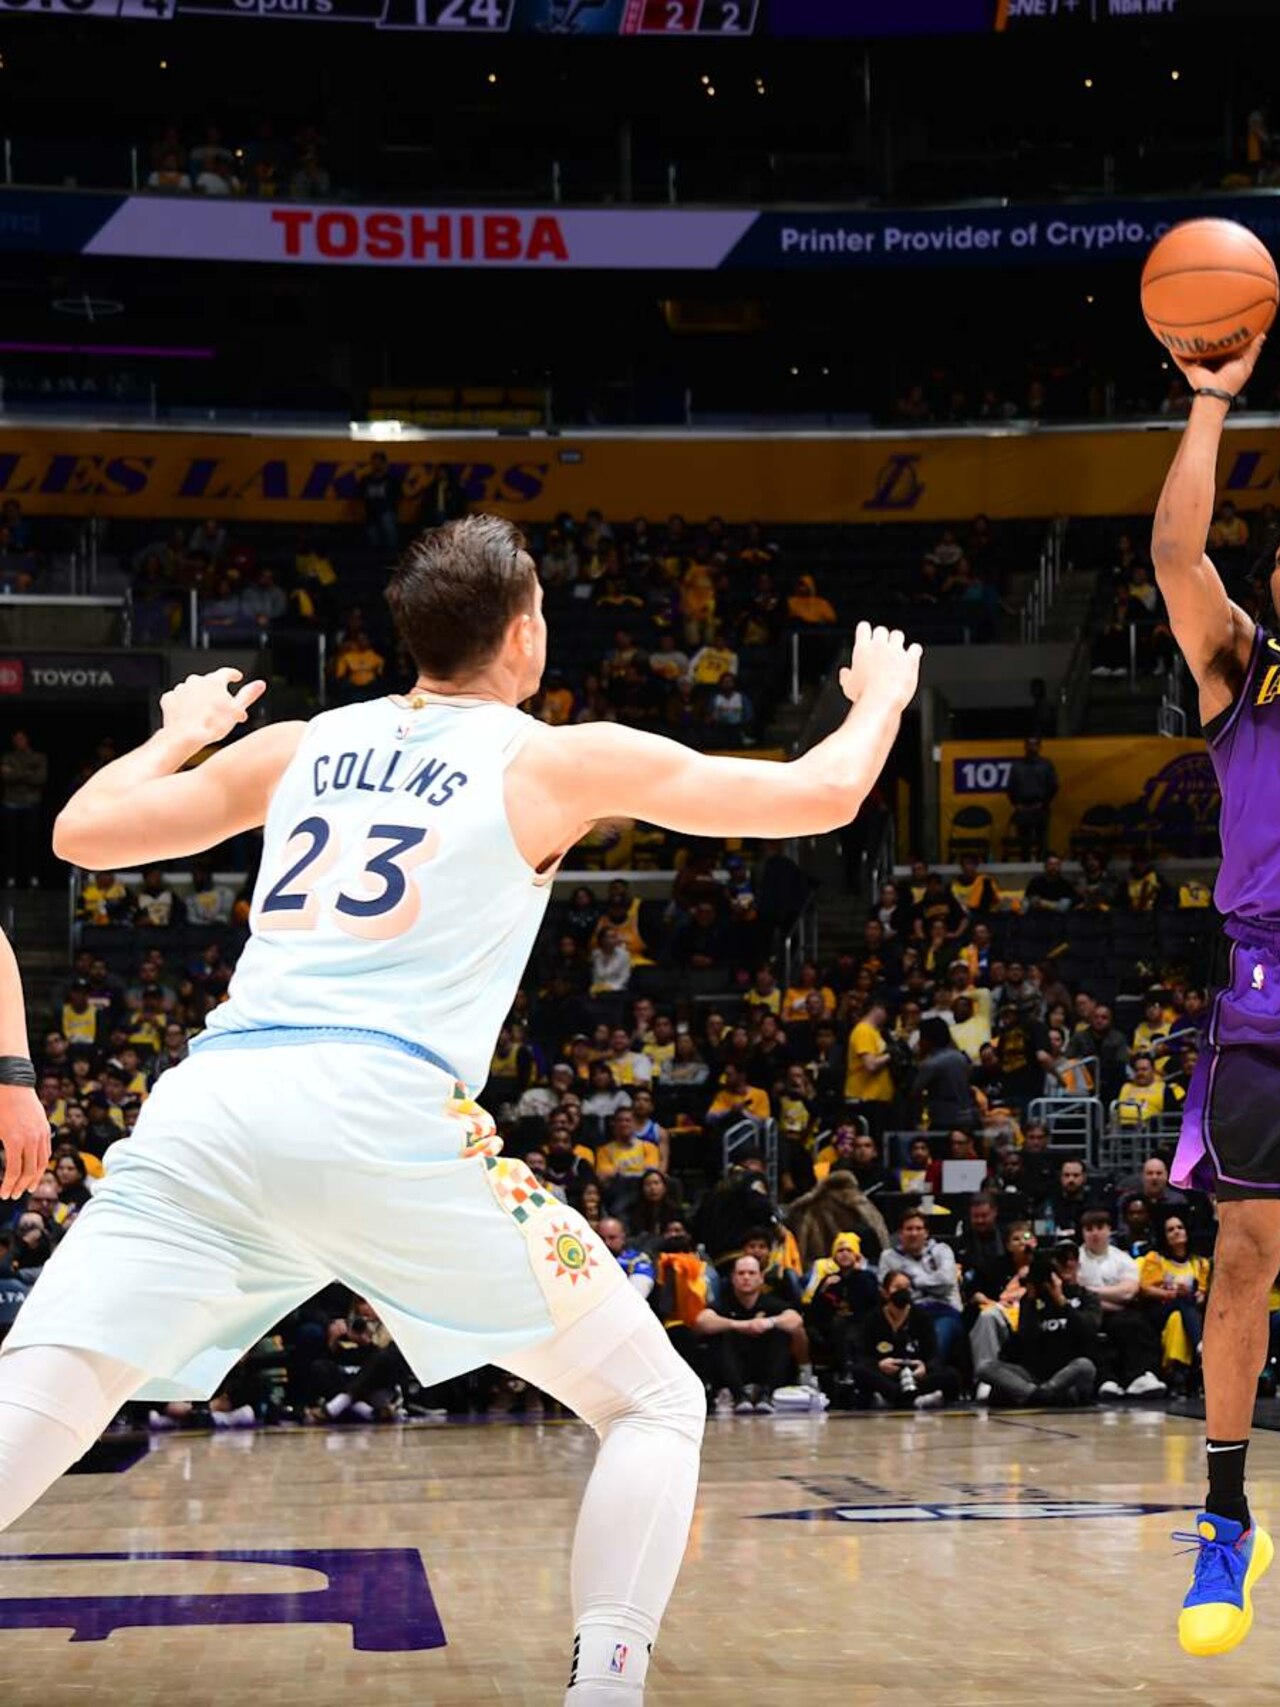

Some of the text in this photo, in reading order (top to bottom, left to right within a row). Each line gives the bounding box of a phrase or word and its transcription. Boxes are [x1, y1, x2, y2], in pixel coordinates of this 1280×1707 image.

[665, 1, 685, 31] 2
[720, 2, 740, 31] 2
[272, 210, 569, 261] TOSHIBA
[781, 227, 875, 253] Printer
[883, 223, 1004, 251] Provider
[1011, 222, 1038, 247] of
[30, 668, 115, 688] TOYOTA
[960, 762, 1013, 790] 107
[261, 816, 432, 920] 23
